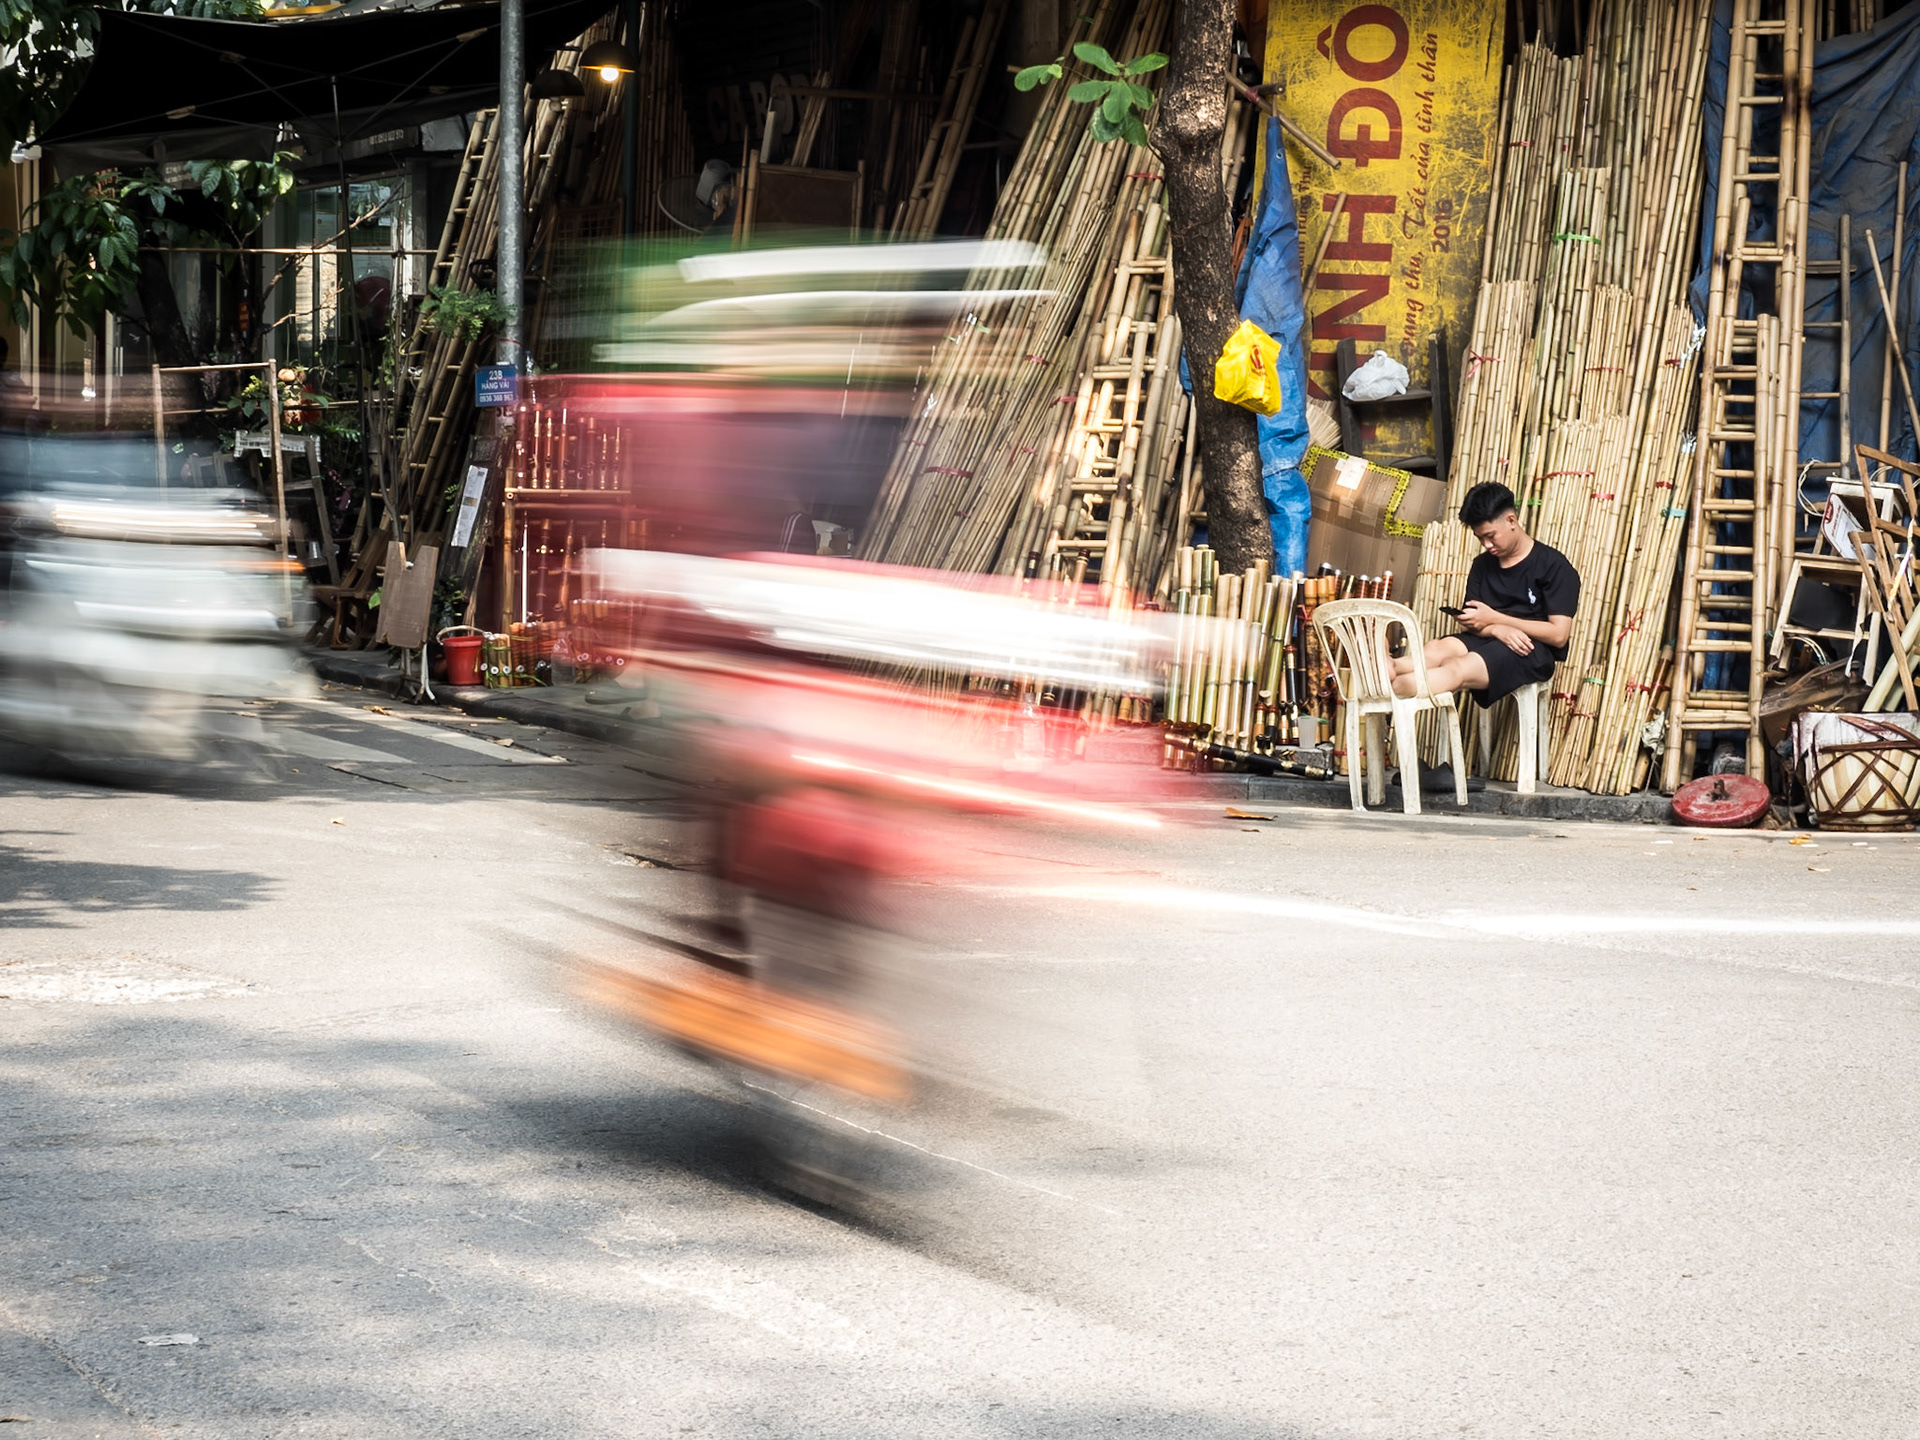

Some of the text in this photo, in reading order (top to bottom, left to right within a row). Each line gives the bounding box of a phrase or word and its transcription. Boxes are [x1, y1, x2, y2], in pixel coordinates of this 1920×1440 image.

[1416, 33, 1438, 82] thân
[1316, 4, 1410, 168] ĐÔ
[1414, 91, 1435, 133] tình
[1409, 142, 1430, 180] của
[1402, 187, 1427, 240] Tết
[1432, 199, 1453, 254] 2016
[1404, 251, 1424, 290] thu,
[488, 370, 503, 380] 23B
